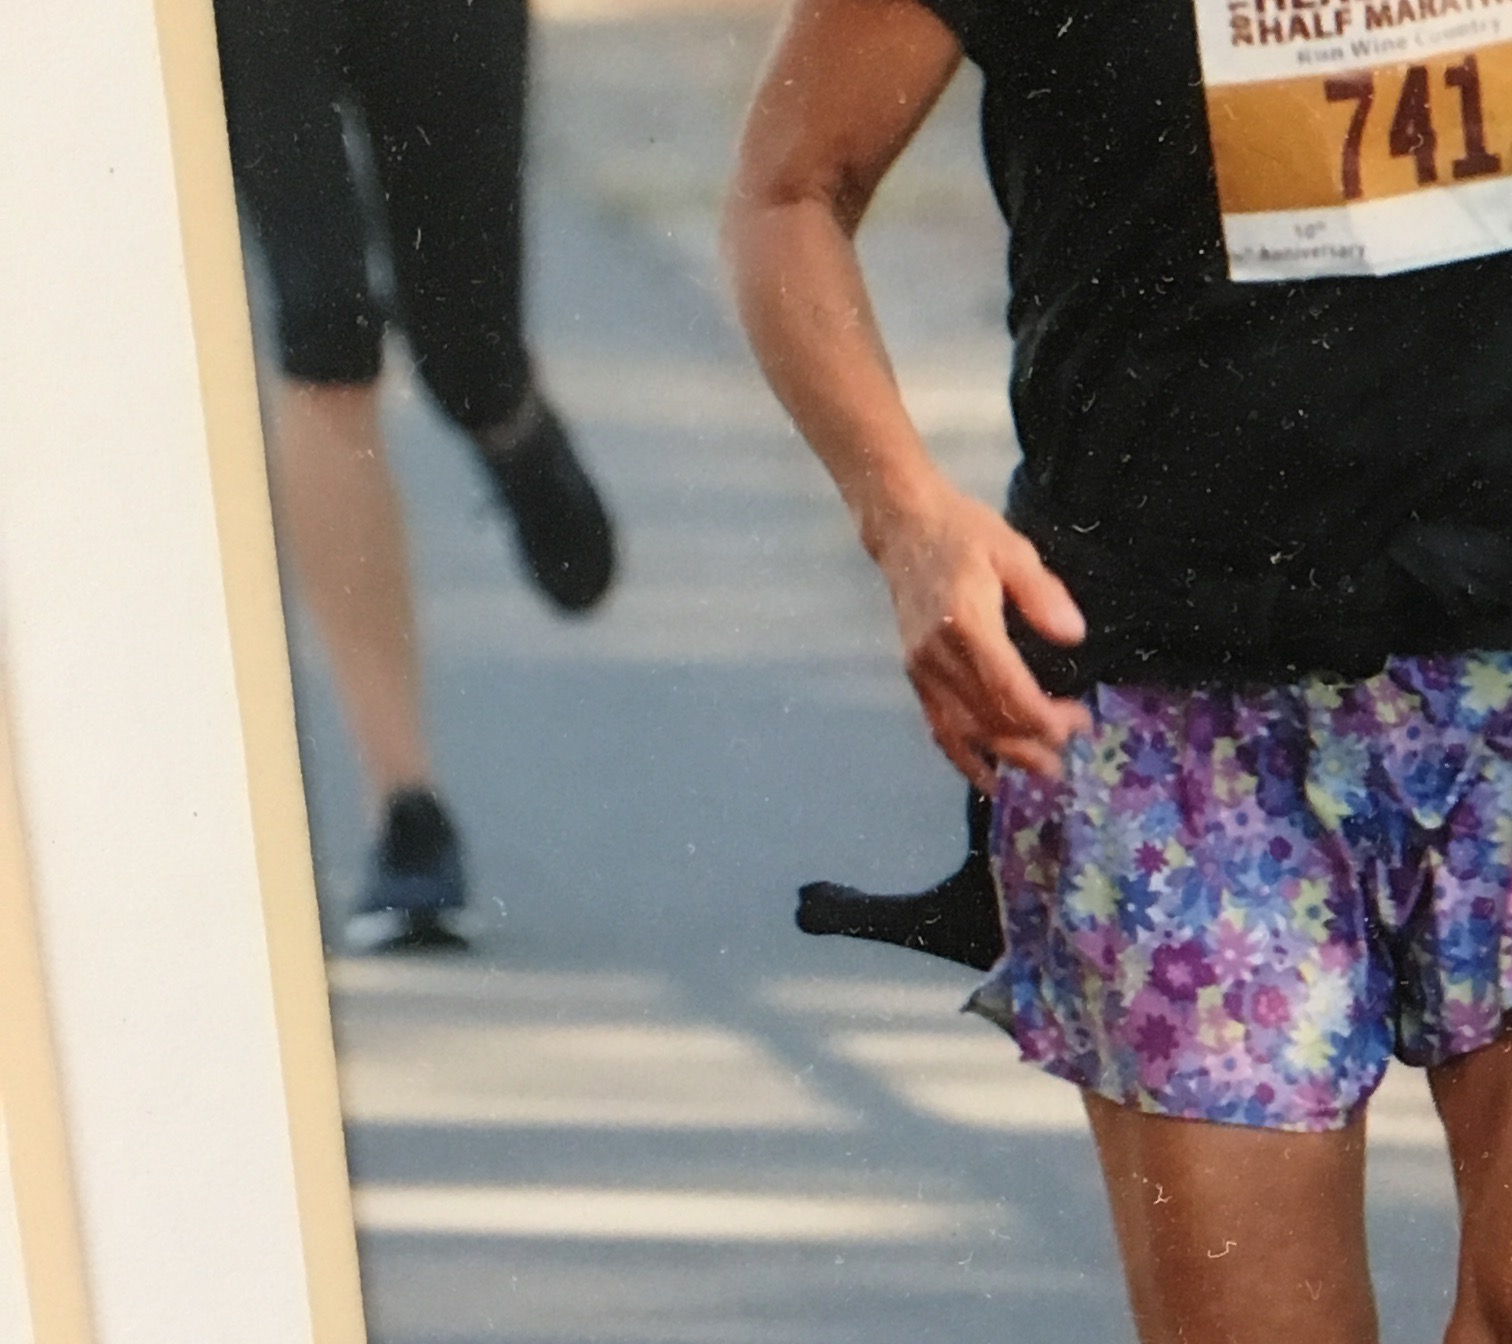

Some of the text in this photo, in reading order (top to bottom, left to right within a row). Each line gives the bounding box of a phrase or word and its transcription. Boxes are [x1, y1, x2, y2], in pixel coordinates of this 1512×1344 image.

[1258, 8, 1352, 46] HALF
[1351, 33, 1407, 58] Wine
[1414, 18, 1500, 47] Country
[1324, 53, 1501, 200] 741
